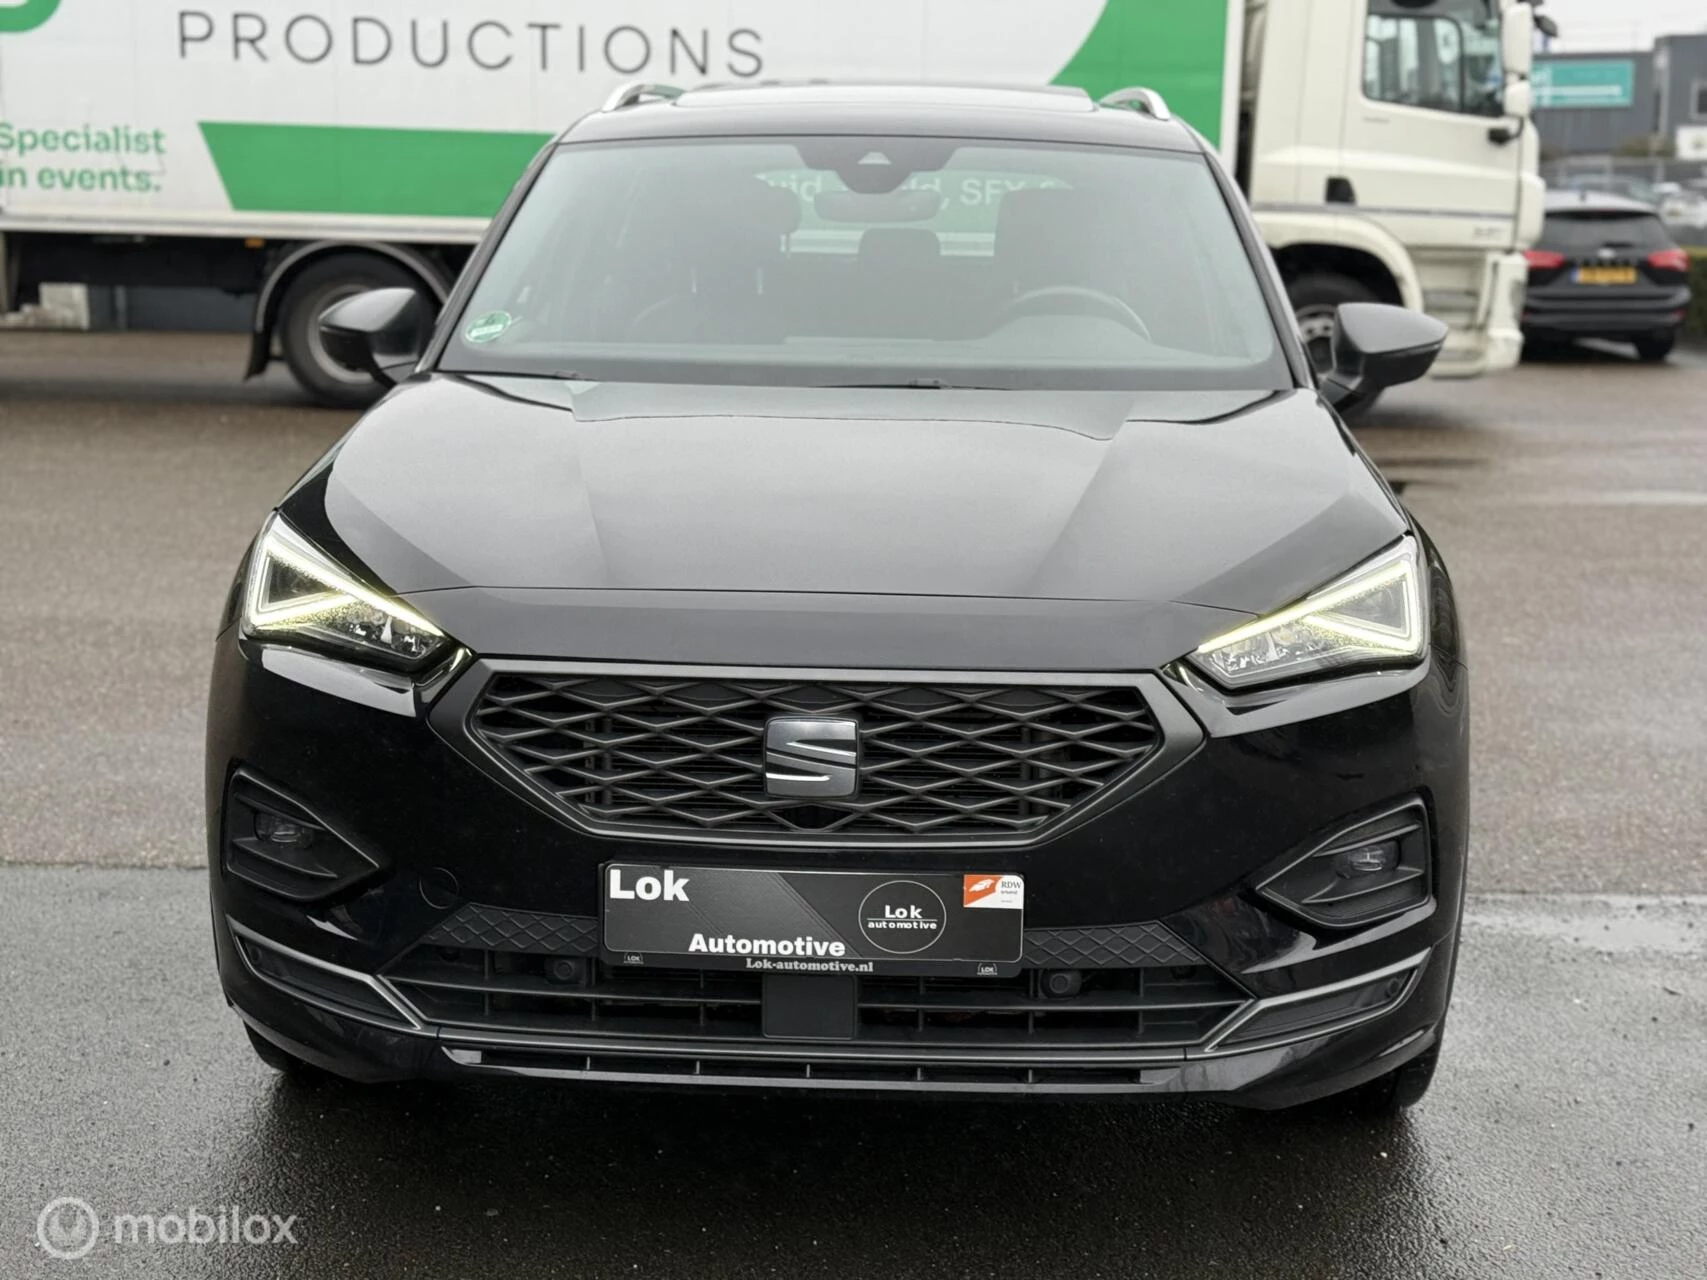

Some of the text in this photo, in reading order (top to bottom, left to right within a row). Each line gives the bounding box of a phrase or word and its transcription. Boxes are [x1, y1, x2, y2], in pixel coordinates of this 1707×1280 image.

[179, 11, 765, 78] PRODUCTIONS
[0, 122, 166, 156] Specialist
[37, 164, 162, 192] events.
[609, 868, 689, 902] Lok
[1001, 881, 1021, 889] RDW
[885, 905, 922, 919] Lok
[868, 921, 937, 930] automotive
[688, 933, 846, 957] Automotive
[745, 957, 874, 973] Lok-automotive.nl
